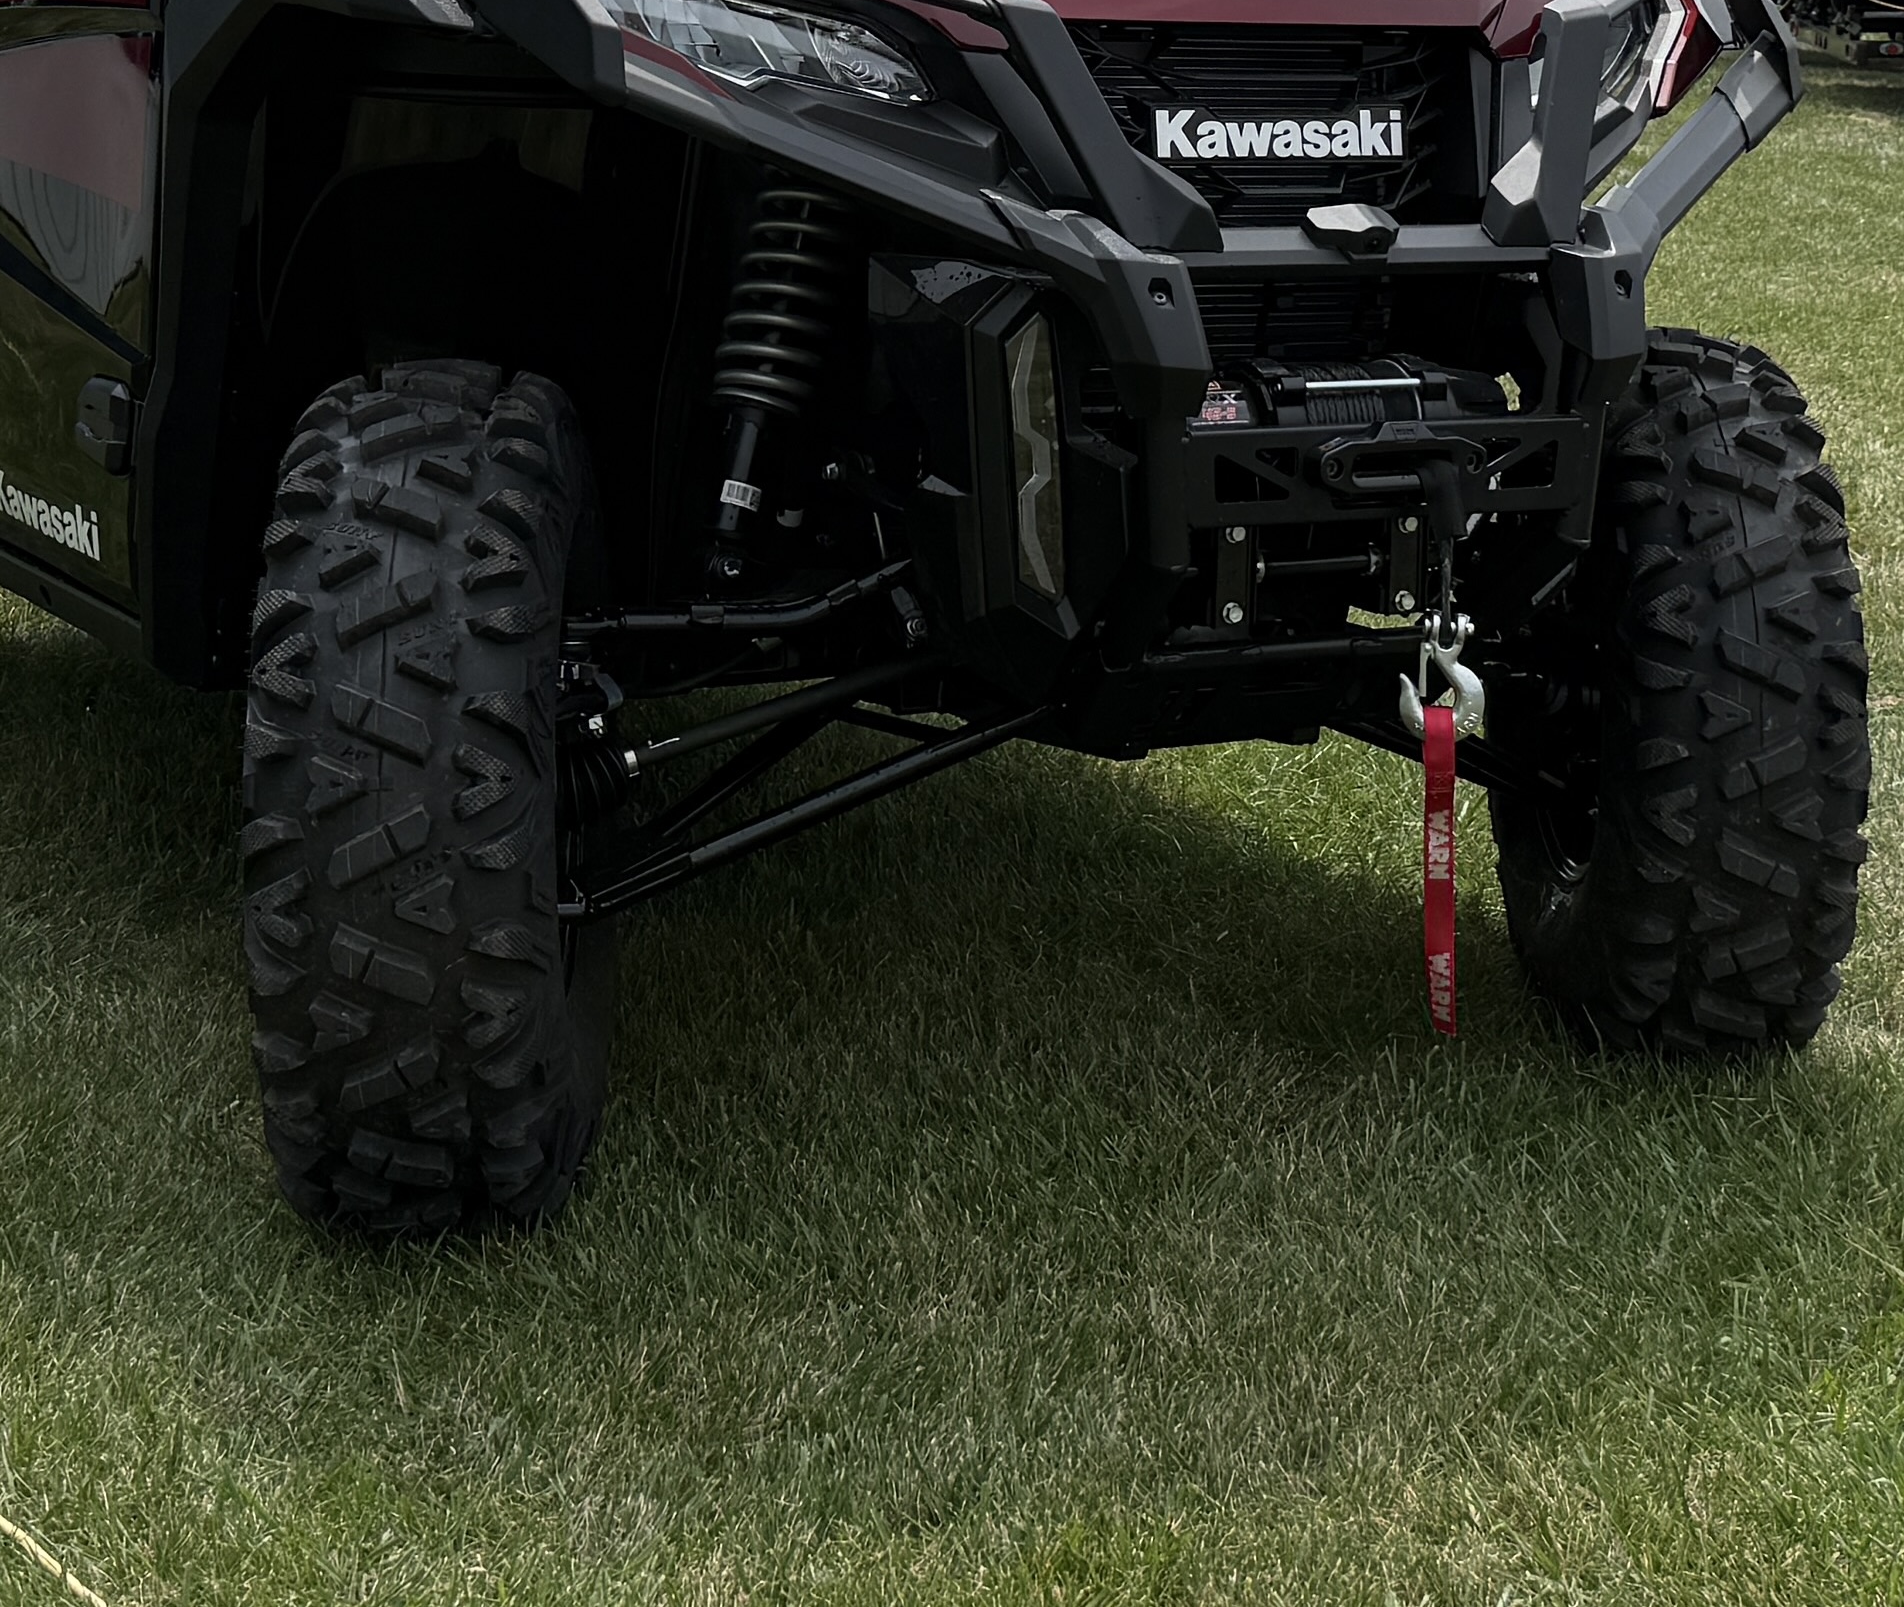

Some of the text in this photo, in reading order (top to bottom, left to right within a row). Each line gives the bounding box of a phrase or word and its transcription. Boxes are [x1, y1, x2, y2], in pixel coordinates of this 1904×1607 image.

[1154, 108, 1404, 159] Kawasaki
[1428, 808, 1451, 880] WARN
[1427, 951, 1452, 1024] WARN
